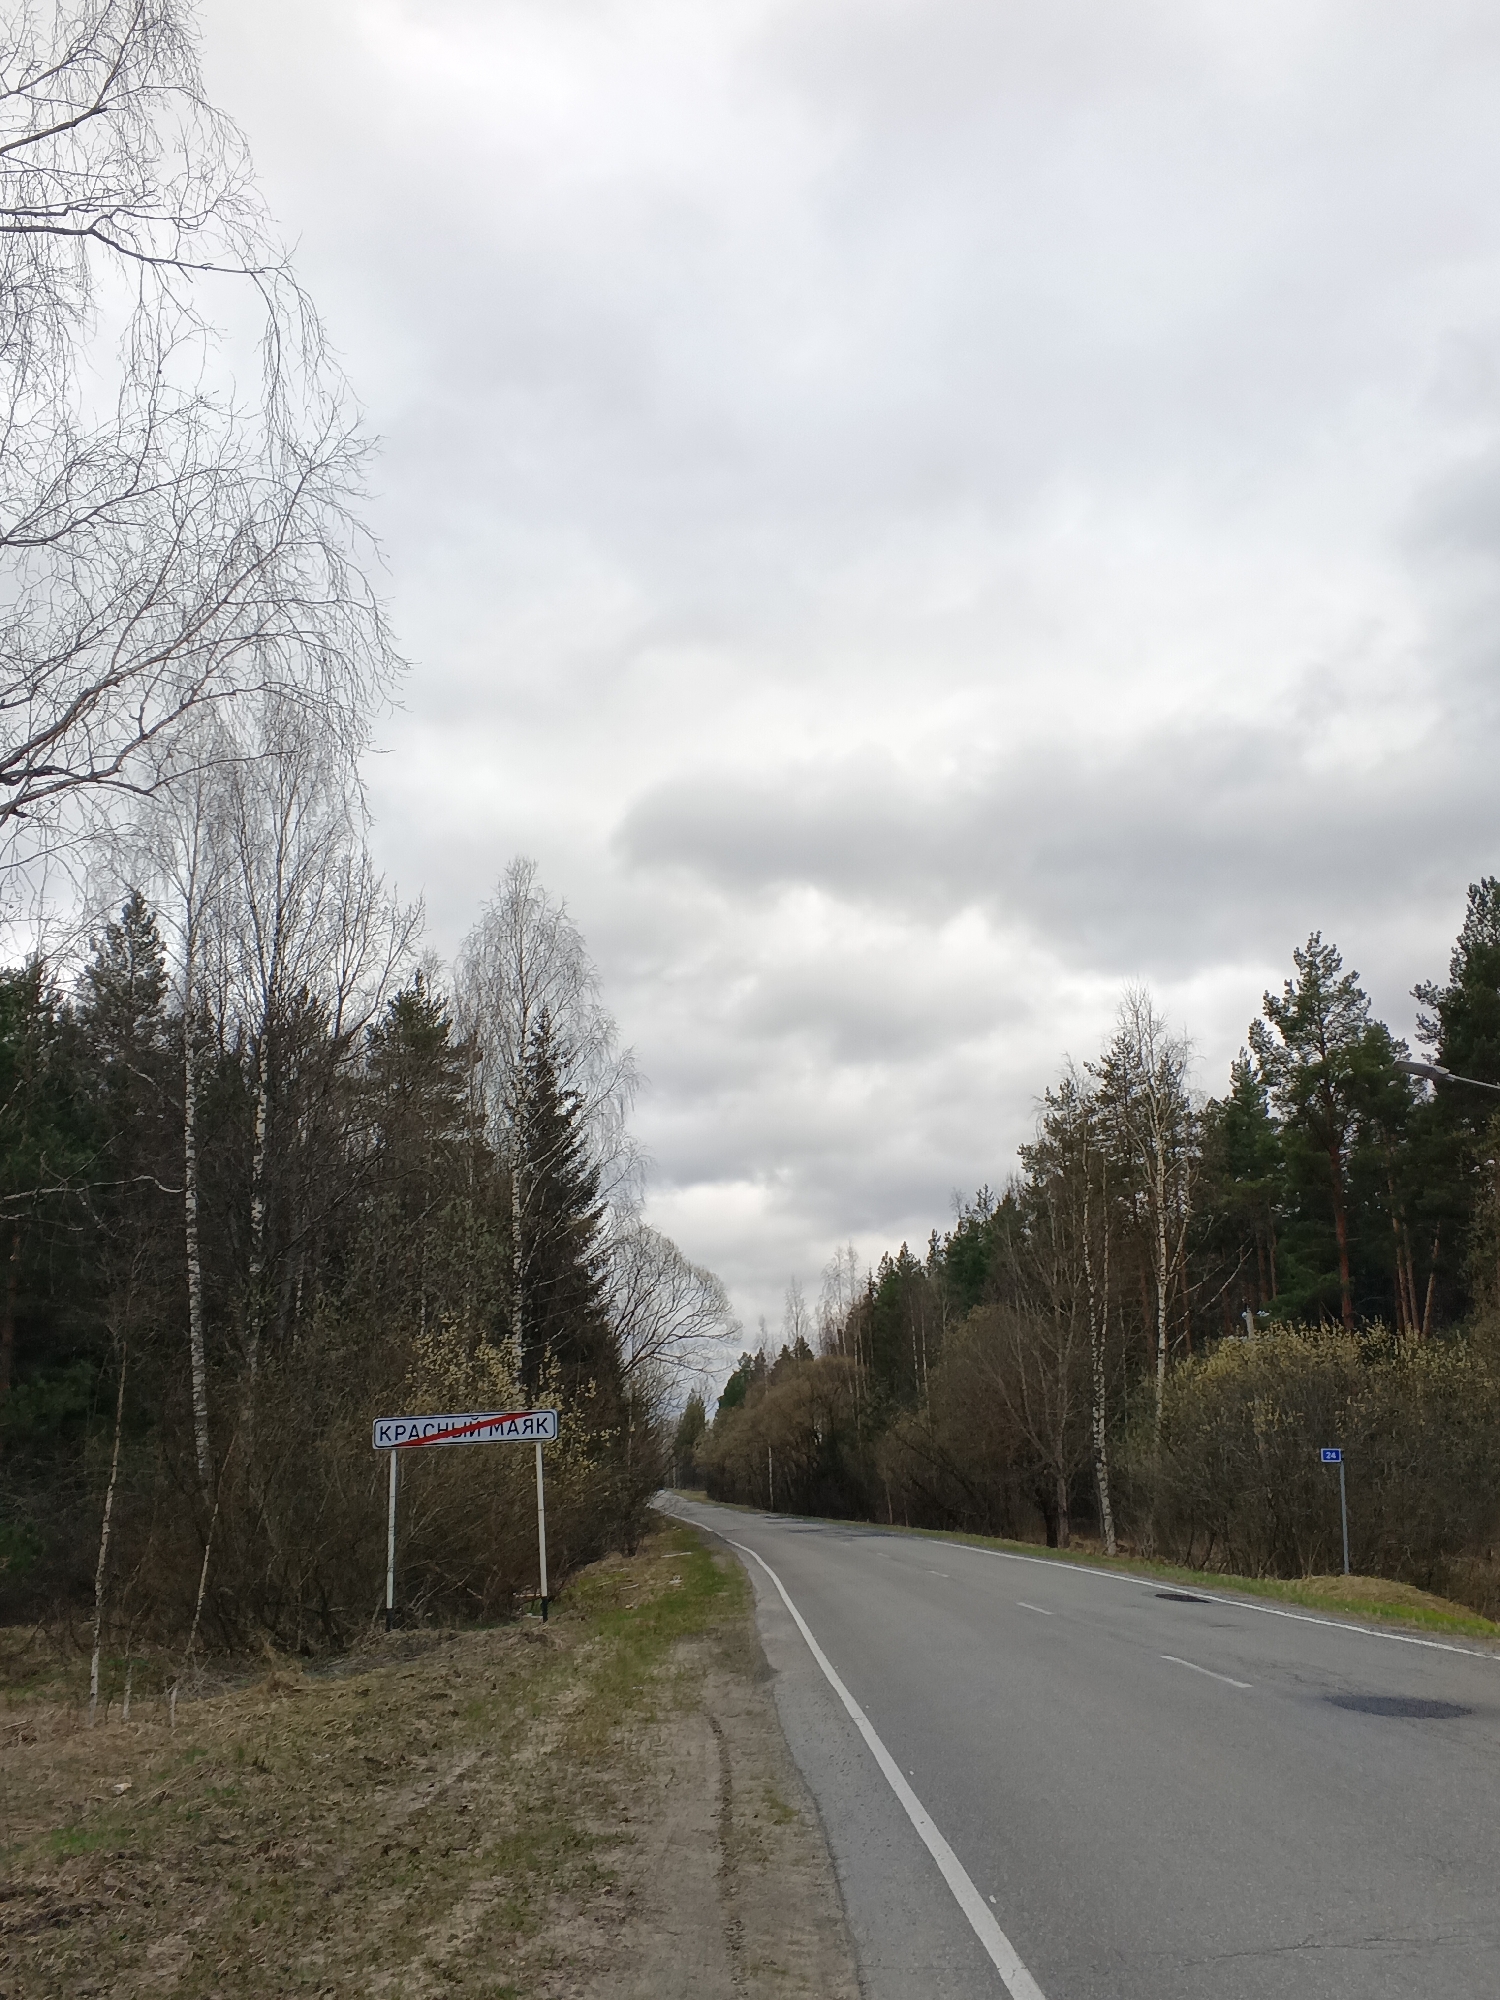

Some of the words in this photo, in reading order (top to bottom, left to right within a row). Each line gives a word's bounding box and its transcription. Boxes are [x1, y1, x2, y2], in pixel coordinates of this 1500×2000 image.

[379, 1416, 481, 1442] КРАСНЫЙ
[489, 1417, 549, 1437] МАЯК
[1325, 1451, 1337, 1460] 24
